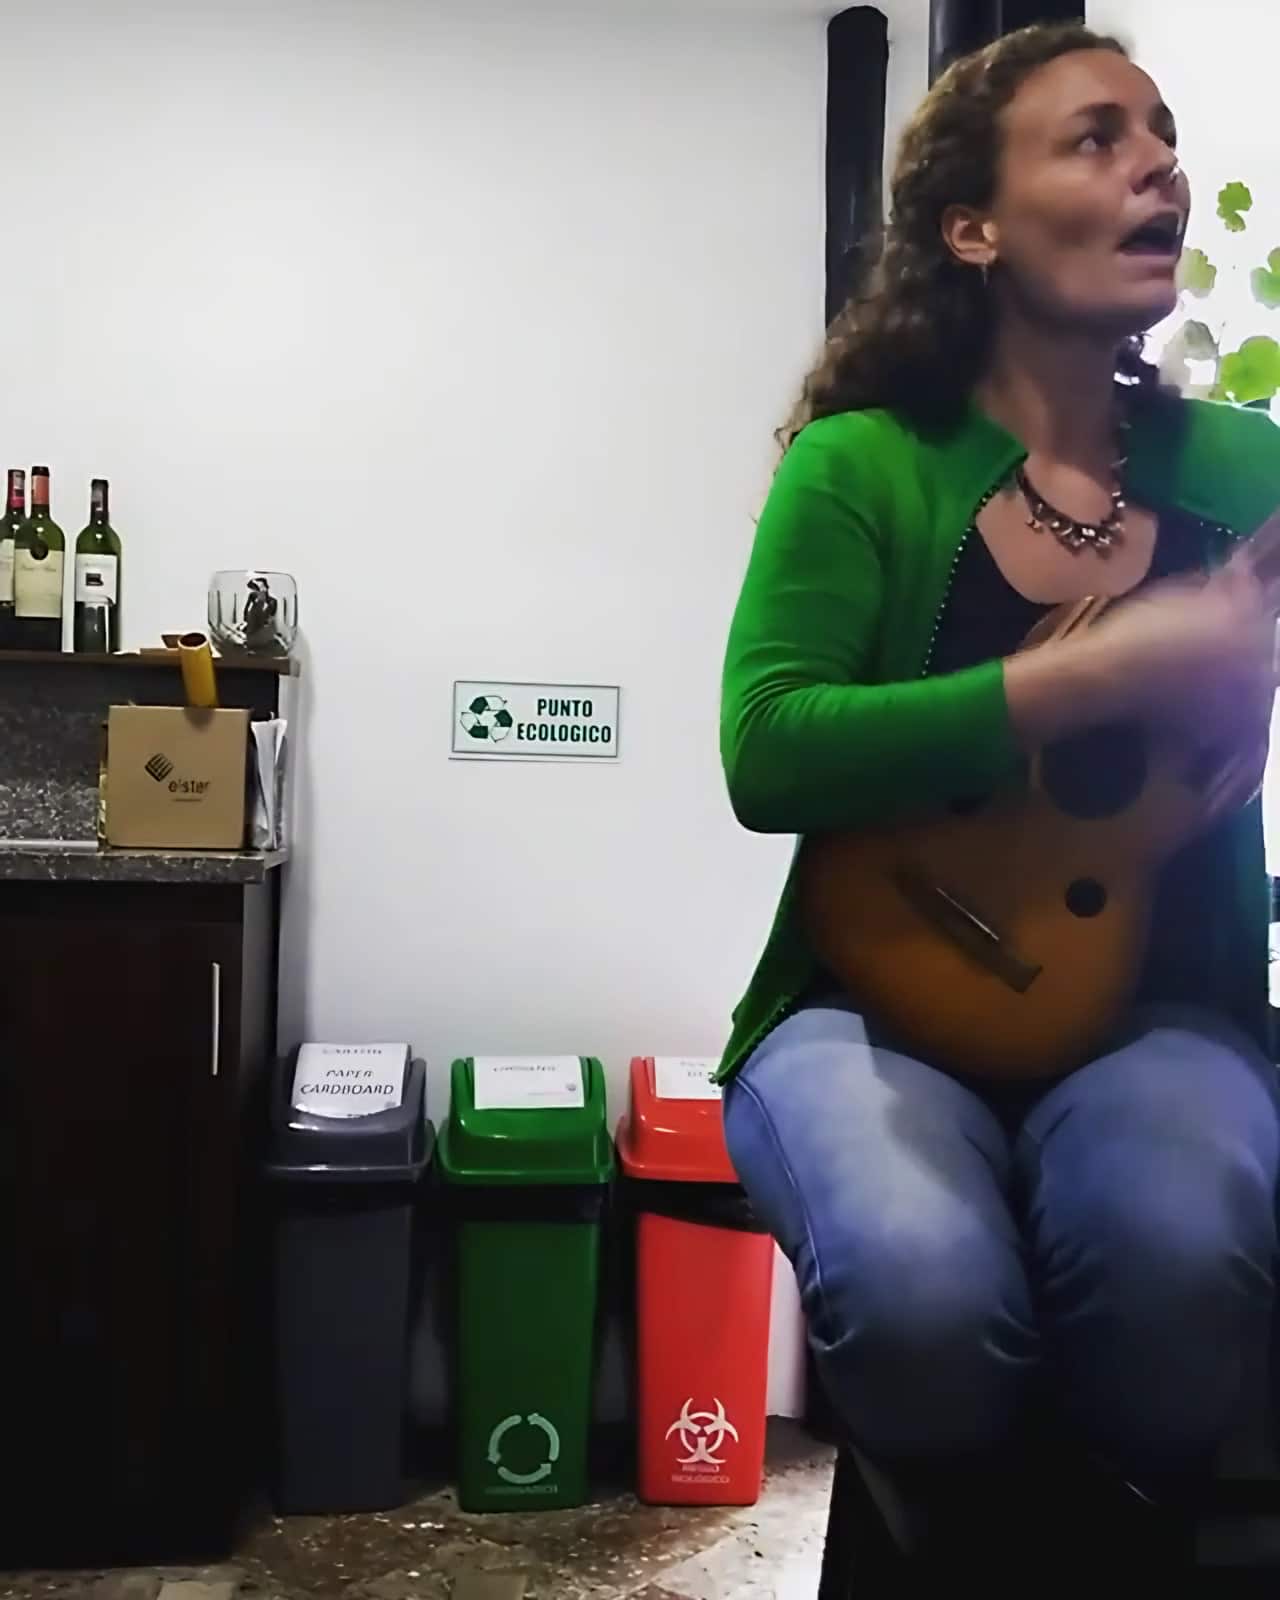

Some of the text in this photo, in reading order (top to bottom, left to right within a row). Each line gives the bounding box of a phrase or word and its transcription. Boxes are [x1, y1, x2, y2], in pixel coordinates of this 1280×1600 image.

[537, 698, 593, 717] PUNTO
[517, 723, 612, 743] ECOLOGICO
[301, 1083, 394, 1095] CARDBOARD
